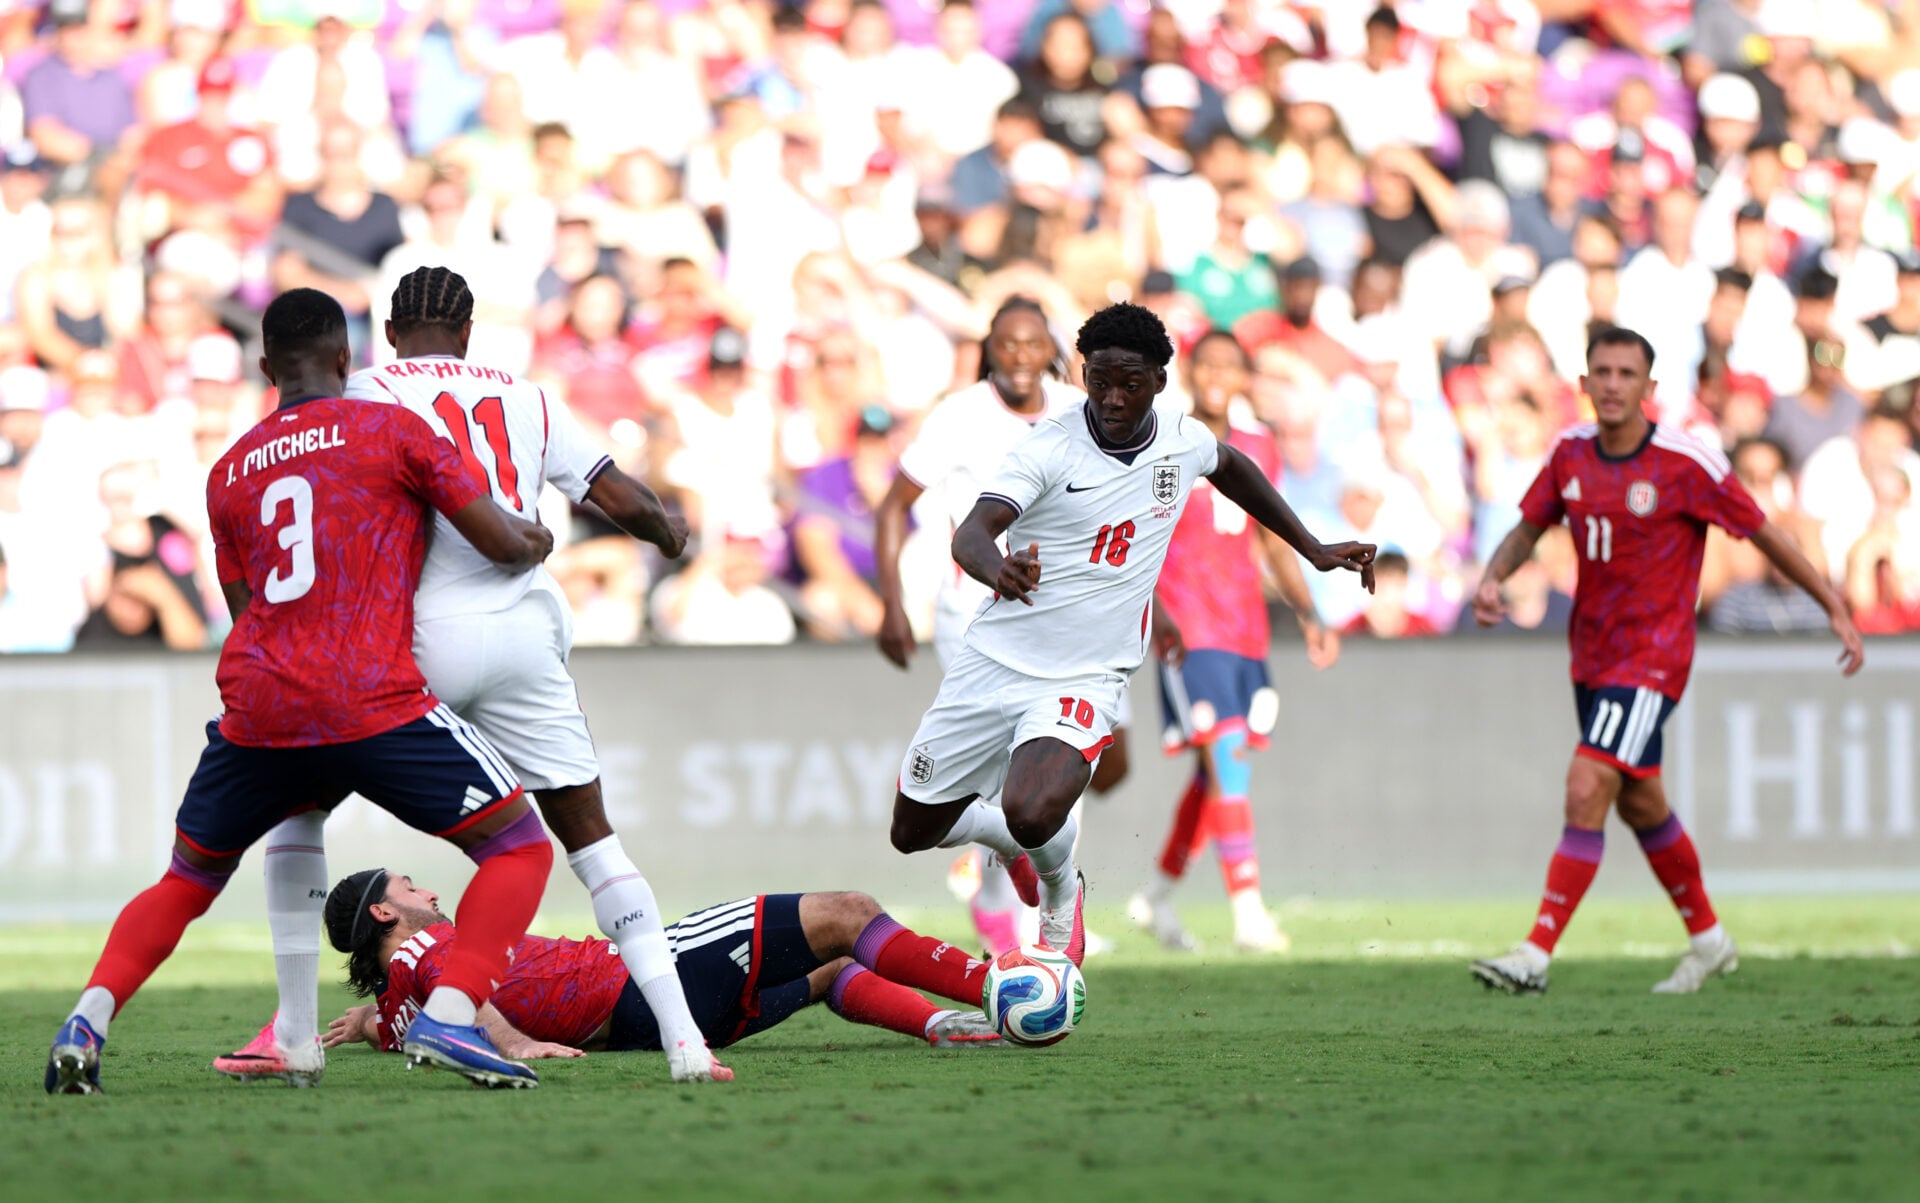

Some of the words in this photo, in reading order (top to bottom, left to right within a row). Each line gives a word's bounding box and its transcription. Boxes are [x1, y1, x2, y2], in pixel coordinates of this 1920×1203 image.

[384, 361, 514, 386] RASHFORD
[225, 462, 237, 487] J.
[242, 424, 346, 478] MITCHELL
[431, 390, 524, 513] 11
[260, 474, 317, 605] 3
[1088, 519, 1136, 568] 16
[1585, 514, 1613, 563] 11
[1058, 696, 1095, 730] 10
[1588, 698, 1624, 749] 11
[680, 738, 899, 830] STAY
[1724, 700, 1917, 840] Hil
[614, 909, 643, 930] ENG
